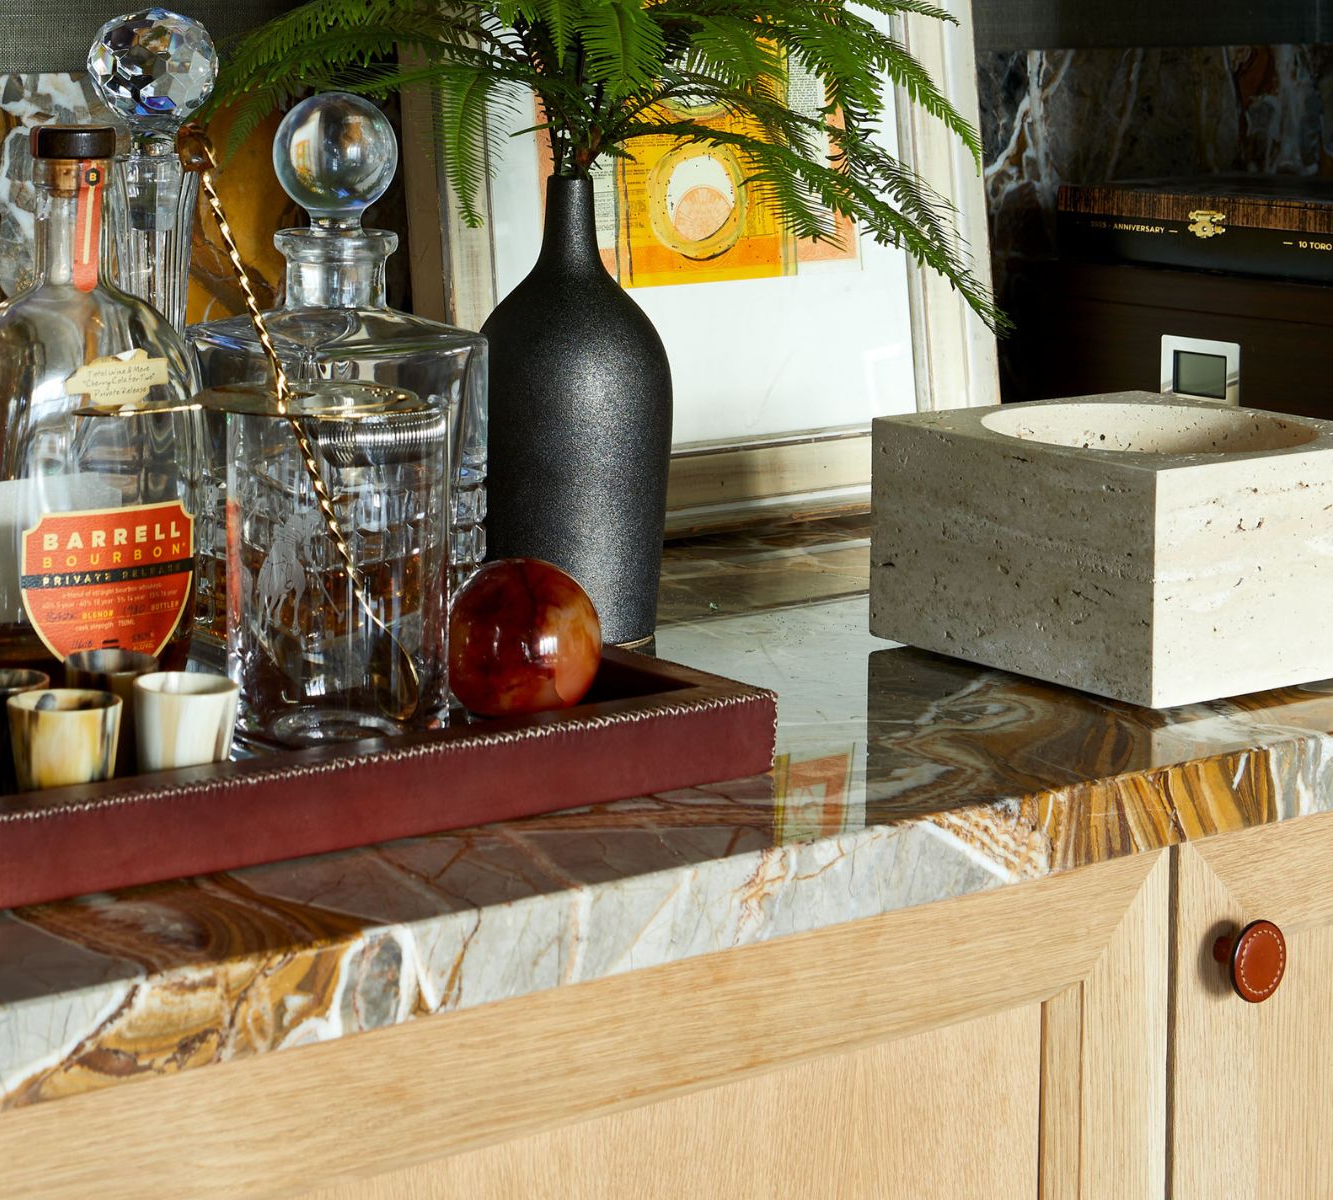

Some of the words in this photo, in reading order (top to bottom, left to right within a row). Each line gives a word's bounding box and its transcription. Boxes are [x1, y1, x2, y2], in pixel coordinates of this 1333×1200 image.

[89, 172, 97, 181] B
[1113, 223, 1165, 234] ANNIVERSARY
[1298, 240, 1307, 248] 10
[1309, 241, 1333, 251] TORO
[132, 365, 150, 373] More
[94, 389, 120, 398] Private
[121, 386, 147, 395] Release
[43, 521, 181, 551] BARRELL
[42, 543, 181, 569] BOURBON
[42, 573, 111, 586] PRIVATE
